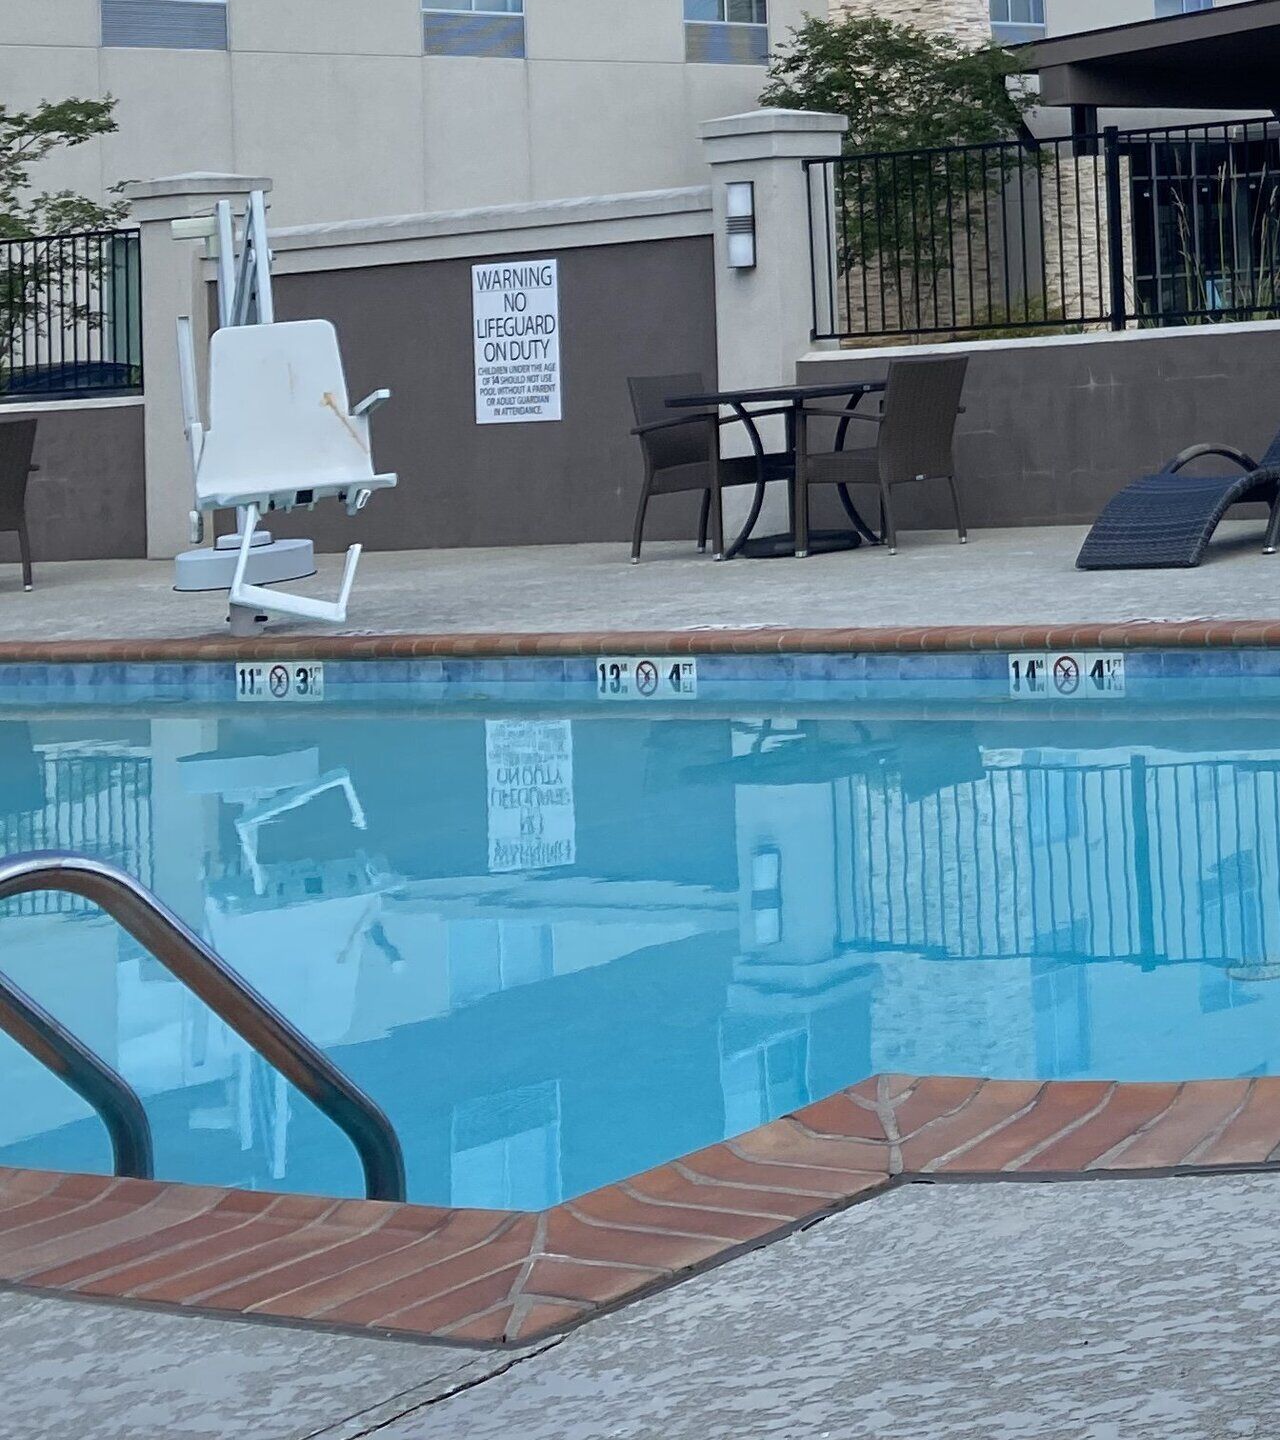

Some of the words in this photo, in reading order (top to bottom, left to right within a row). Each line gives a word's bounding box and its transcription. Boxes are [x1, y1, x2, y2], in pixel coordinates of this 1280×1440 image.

[476, 266, 552, 290] WARNING
[504, 292, 526, 312] NO
[476, 314, 556, 338] LIFEGUARD
[484, 342, 507, 362] ON
[510, 339, 550, 360] DUTY
[509, 365, 530, 374] UNDER
[544, 363, 555, 371] AGE
[501, 375, 526, 384] SHOULD
[527, 374, 539, 383] NOT
[541, 374, 552, 382] USE
[480, 387, 496, 396] POOL
